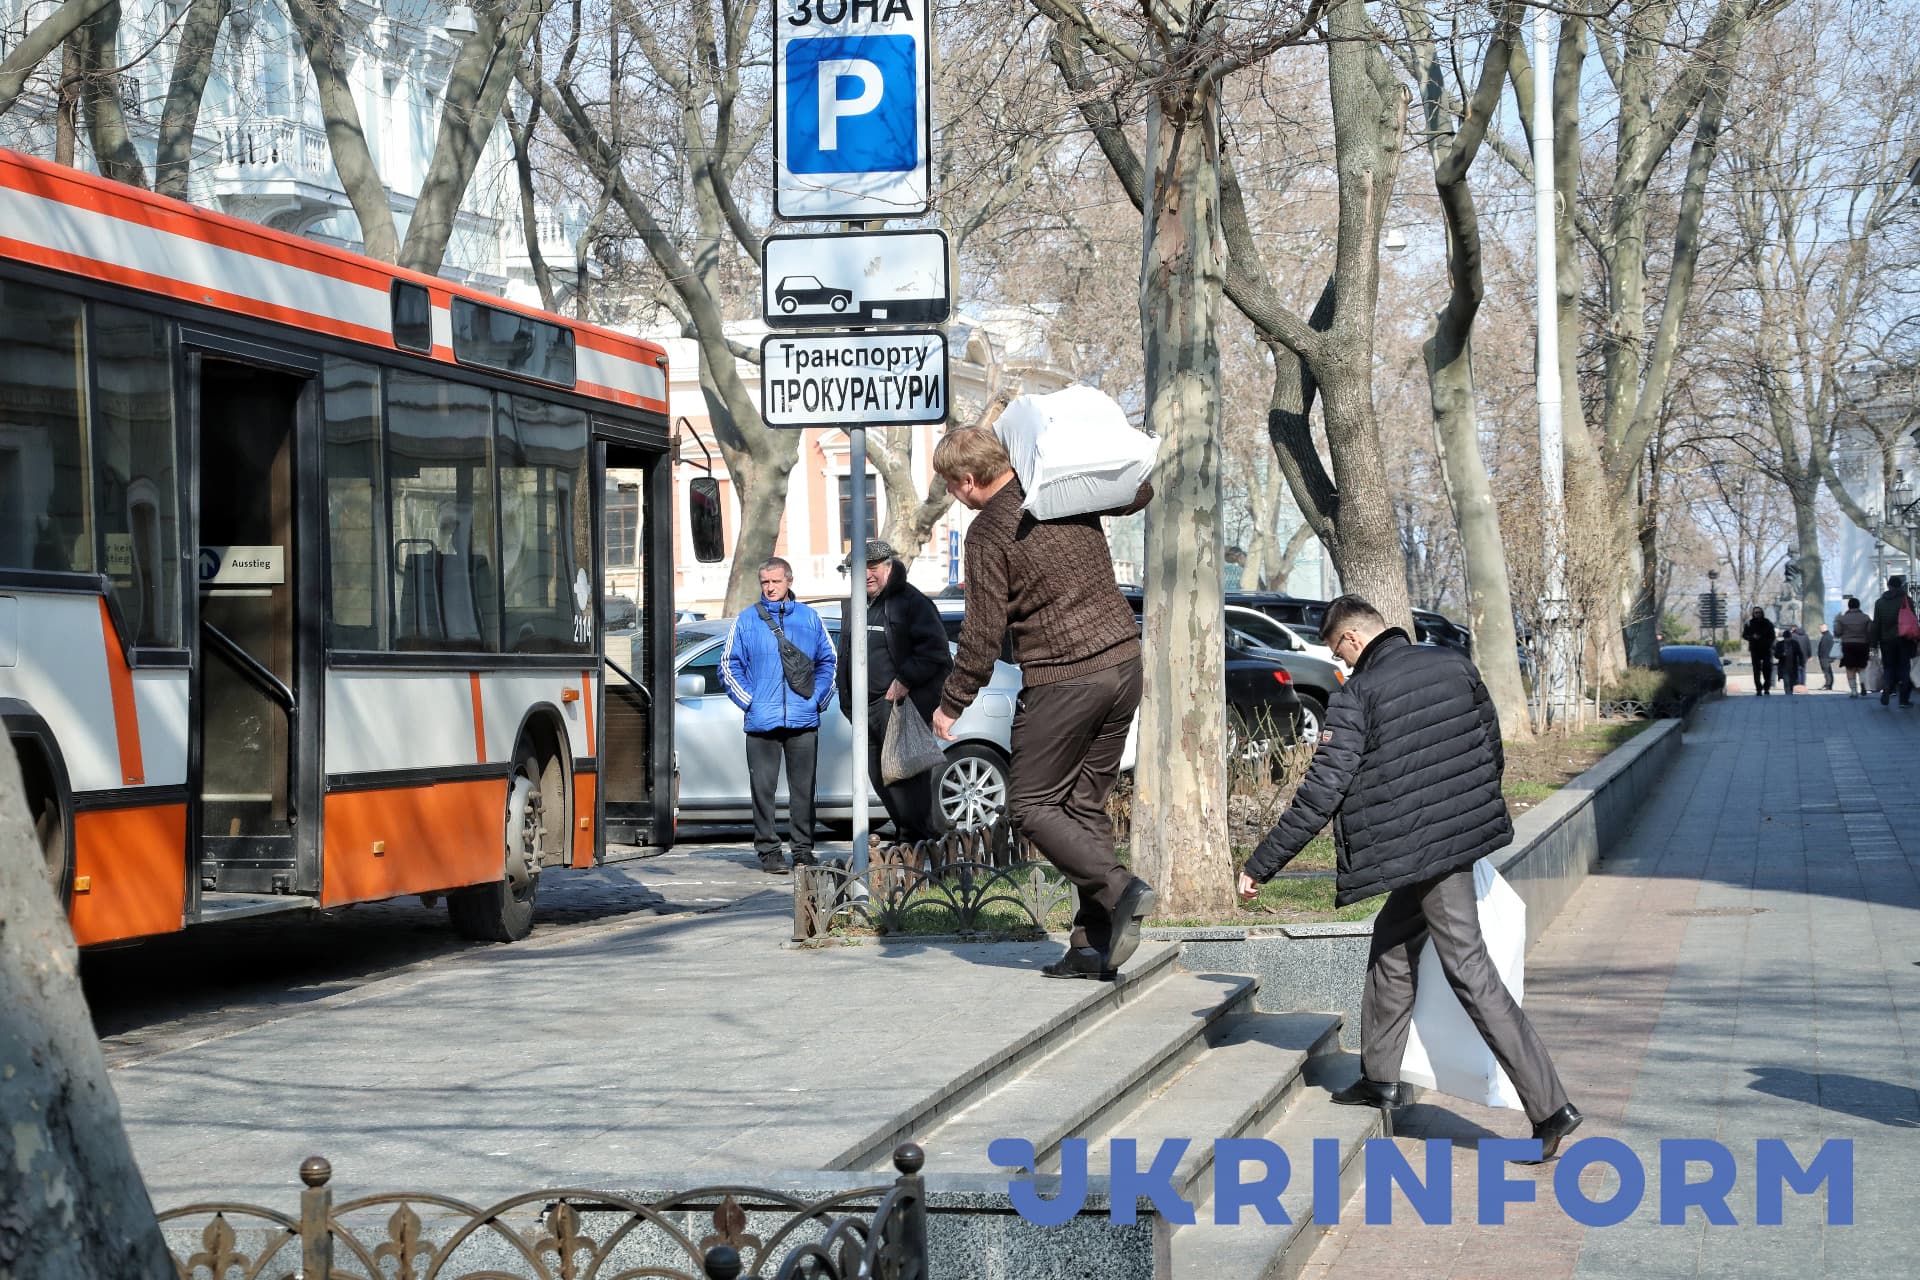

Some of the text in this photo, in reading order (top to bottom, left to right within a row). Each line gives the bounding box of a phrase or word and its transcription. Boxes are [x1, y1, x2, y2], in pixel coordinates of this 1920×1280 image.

[818, 59, 883, 151] P
[780, 344, 928, 374] Транспорту
[771, 375, 940, 413] ПРОКУРАТУРИ
[232, 559, 271, 569] Ausstieg
[573, 614, 591, 643] 2114
